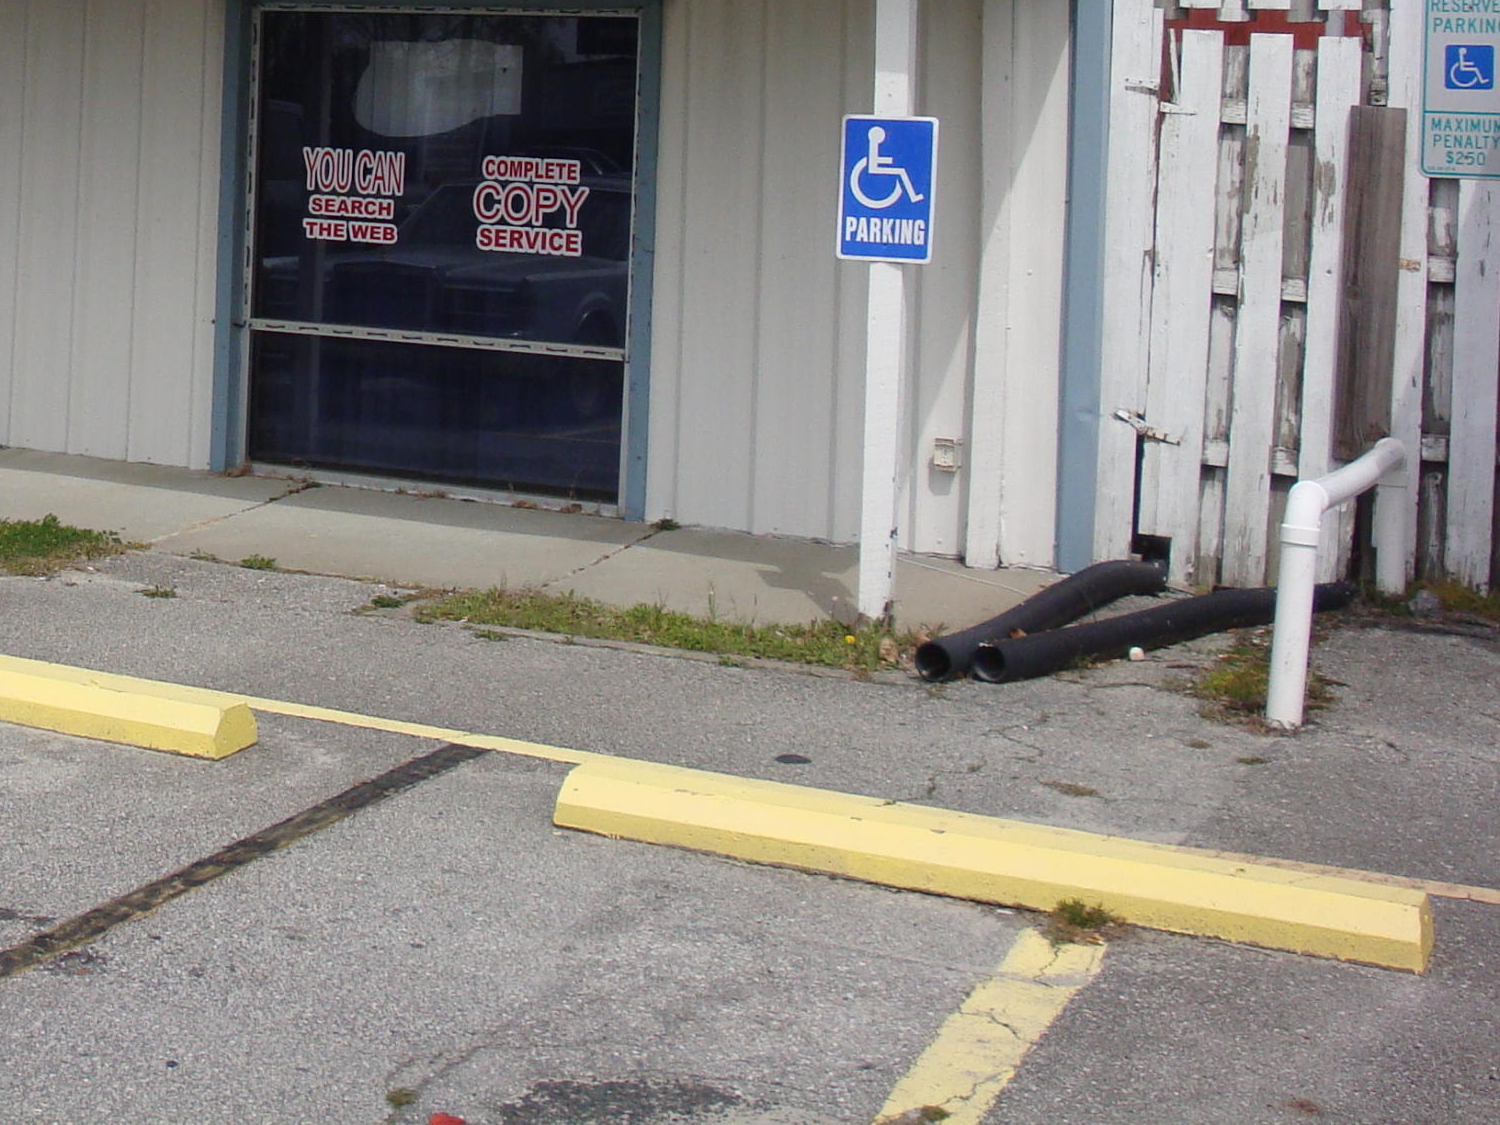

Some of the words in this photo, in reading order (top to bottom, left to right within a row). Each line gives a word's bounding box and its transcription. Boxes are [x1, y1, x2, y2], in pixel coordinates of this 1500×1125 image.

[1433, 17, 1500, 34] PARKIN
[1433, 134, 1500, 150] PENALTY
[303, 147, 352, 192] YOU
[355, 149, 405, 196] CAN
[482, 155, 581, 184] COMPLETE
[1445, 151, 1486, 166] $250
[309, 195, 394, 220] SEARCH
[473, 181, 589, 227] COPY
[303, 219, 347, 241] THE
[350, 222, 398, 244] WEB
[476, 225, 582, 256] SERVICE
[845, 216, 926, 246] PARKING
